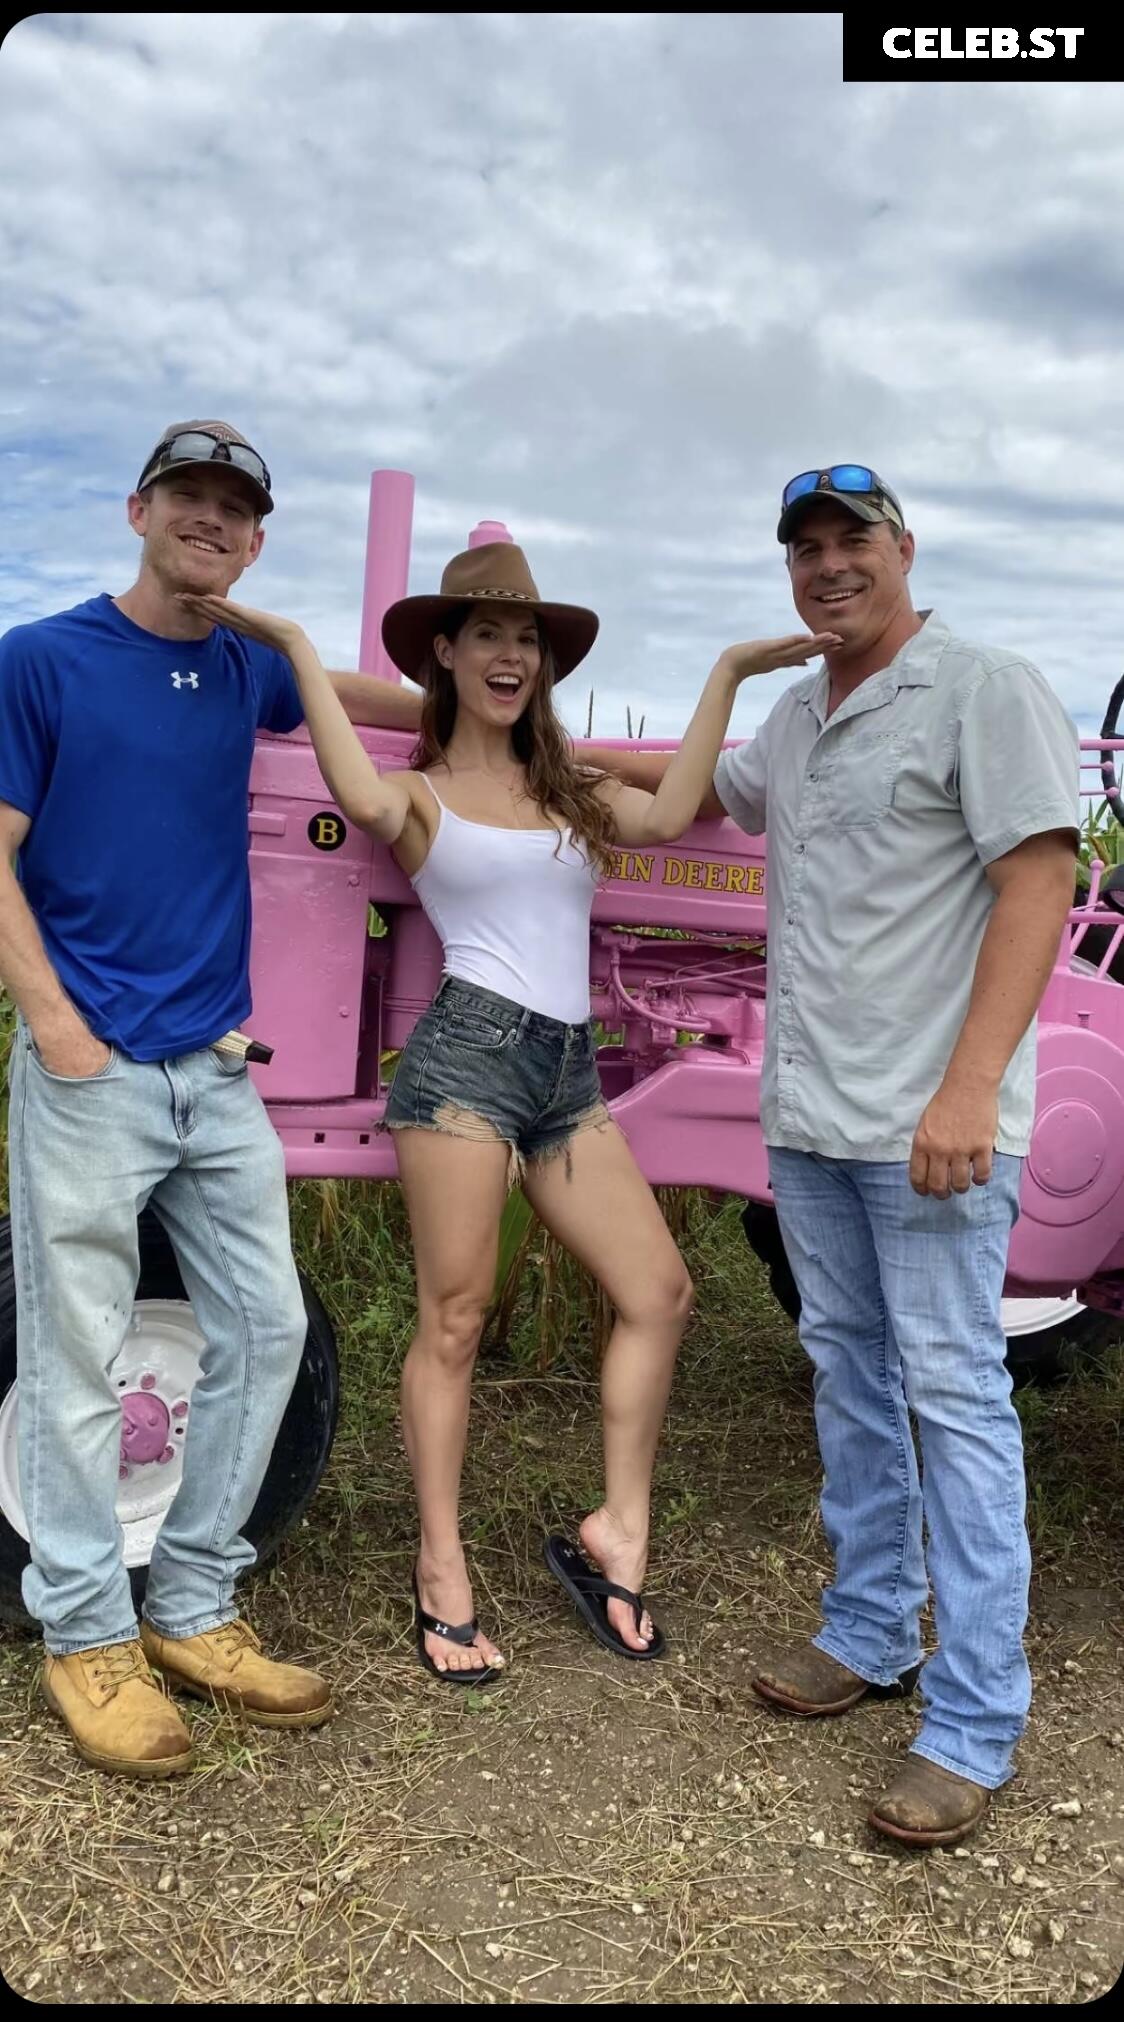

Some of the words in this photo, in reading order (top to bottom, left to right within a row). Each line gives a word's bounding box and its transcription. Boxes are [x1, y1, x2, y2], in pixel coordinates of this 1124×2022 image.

[316, 818, 338, 844] B
[605, 851, 655, 883] HN
[662, 857, 765, 895] DEERE
